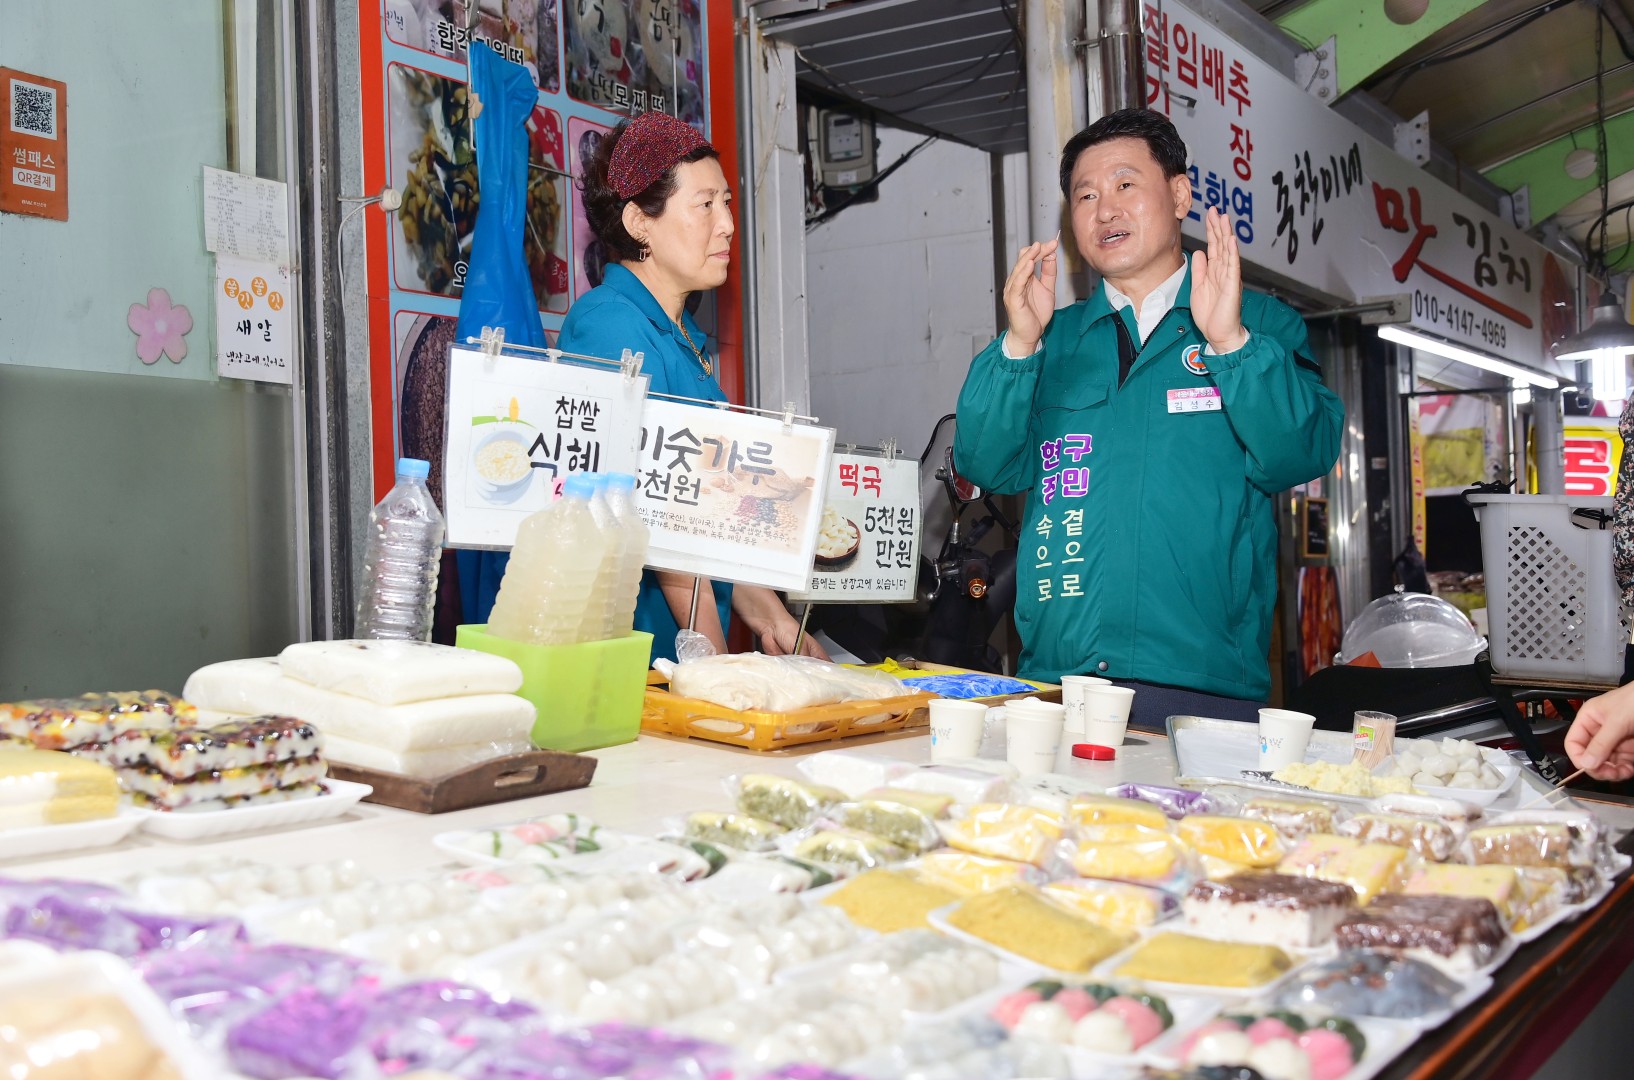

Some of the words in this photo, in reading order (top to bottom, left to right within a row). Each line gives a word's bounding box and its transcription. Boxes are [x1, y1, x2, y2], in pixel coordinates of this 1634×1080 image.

[1144, 2, 1251, 117] 절임배추
[13, 147, 56, 169] 썸패스
[17, 171, 51, 188] QR결제
[1452, 212, 1532, 293] 김치
[1414, 289, 1507, 349] 010-4147-4969
[555, 395, 600, 432] 찹쌀
[527, 432, 600, 482] 식혜
[1062, 434, 1093, 498] 구민
[839, 463, 882, 498] 떡국
[864, 506, 914, 536] 5천원
[876, 539, 914, 569] 만원
[1036, 513, 1053, 602] 속으로
[1060, 508, 1085, 598] 곁으로
[811, 577, 837, 590] 름에는
[840, 578, 873, 590] 냉장고에
[876, 578, 907, 591] 있습니다
